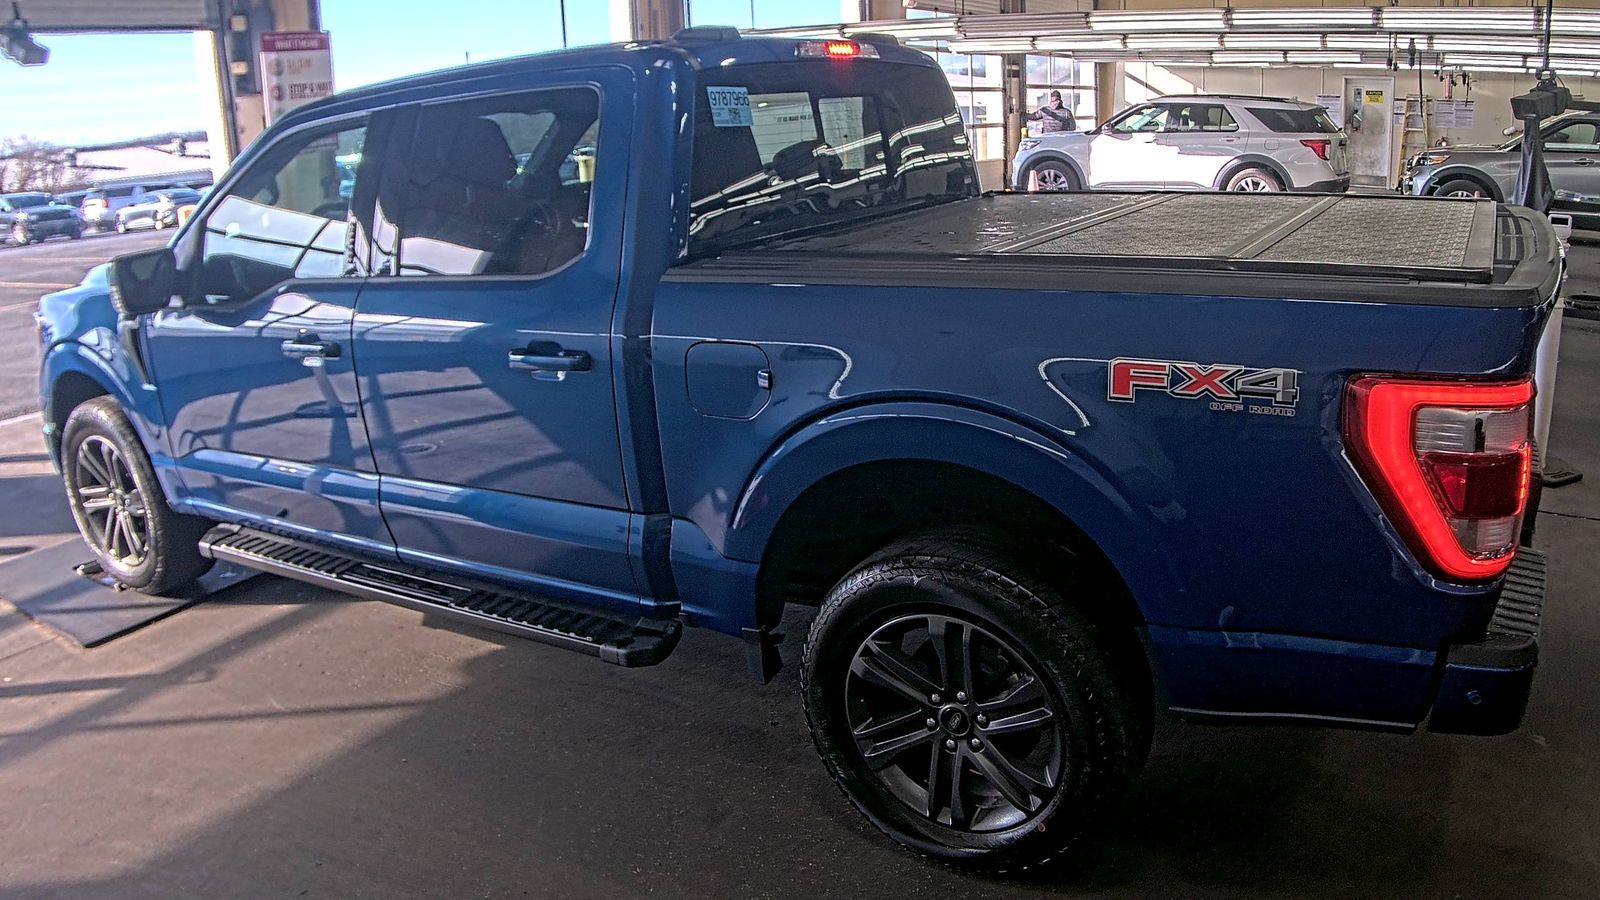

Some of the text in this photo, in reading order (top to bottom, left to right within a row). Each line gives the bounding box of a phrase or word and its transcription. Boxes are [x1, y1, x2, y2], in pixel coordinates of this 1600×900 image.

[1108, 357, 1299, 408] FX4
[1209, 402, 1296, 417] OFF ROAD
